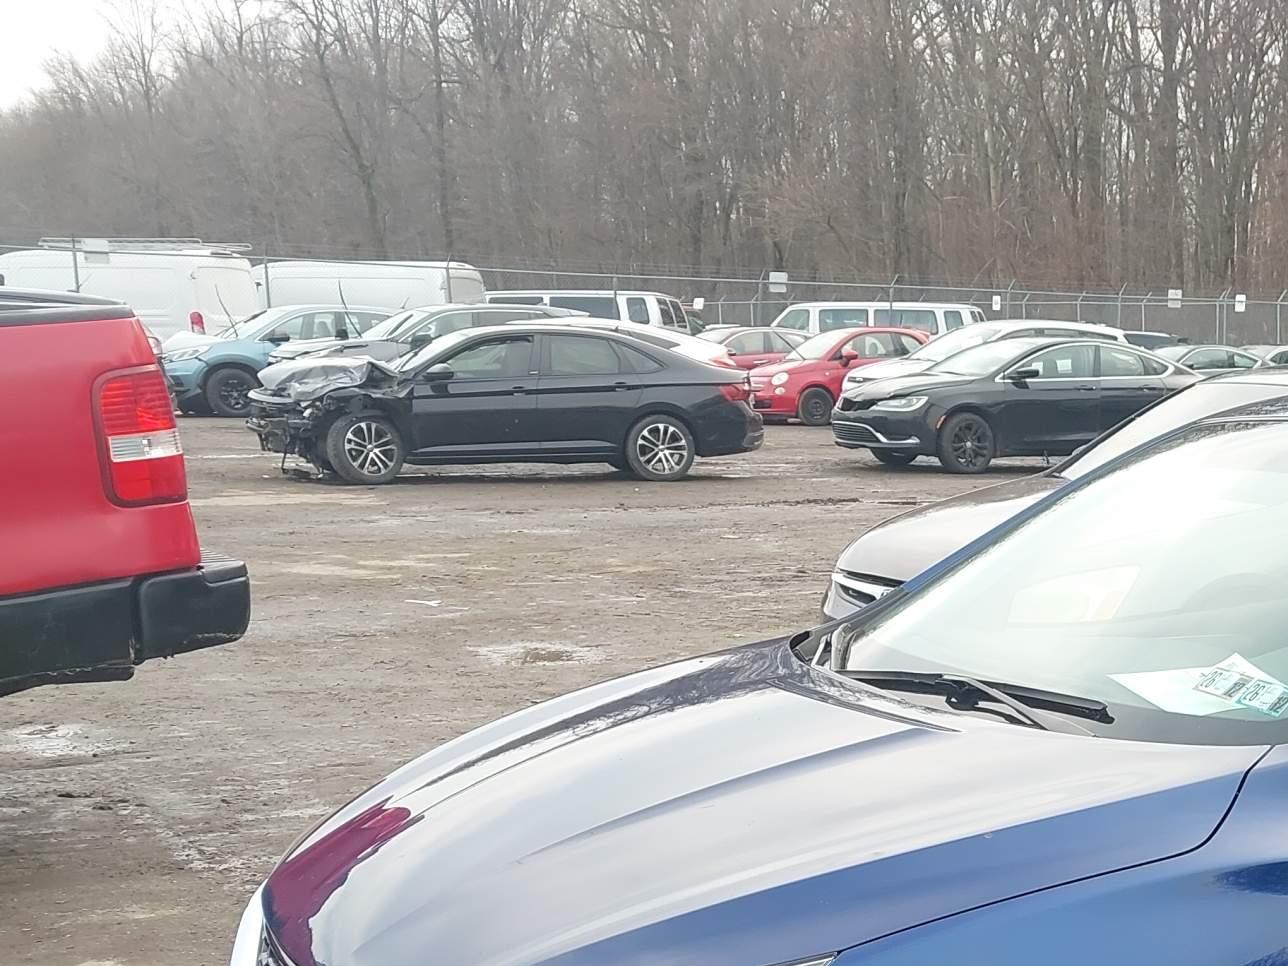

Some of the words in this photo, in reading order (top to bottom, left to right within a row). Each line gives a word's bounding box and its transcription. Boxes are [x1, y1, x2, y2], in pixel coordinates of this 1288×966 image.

[1200, 670, 1223, 688] 26
[1223, 681, 1246, 697] 12
[1243, 683, 1266, 701] 26
